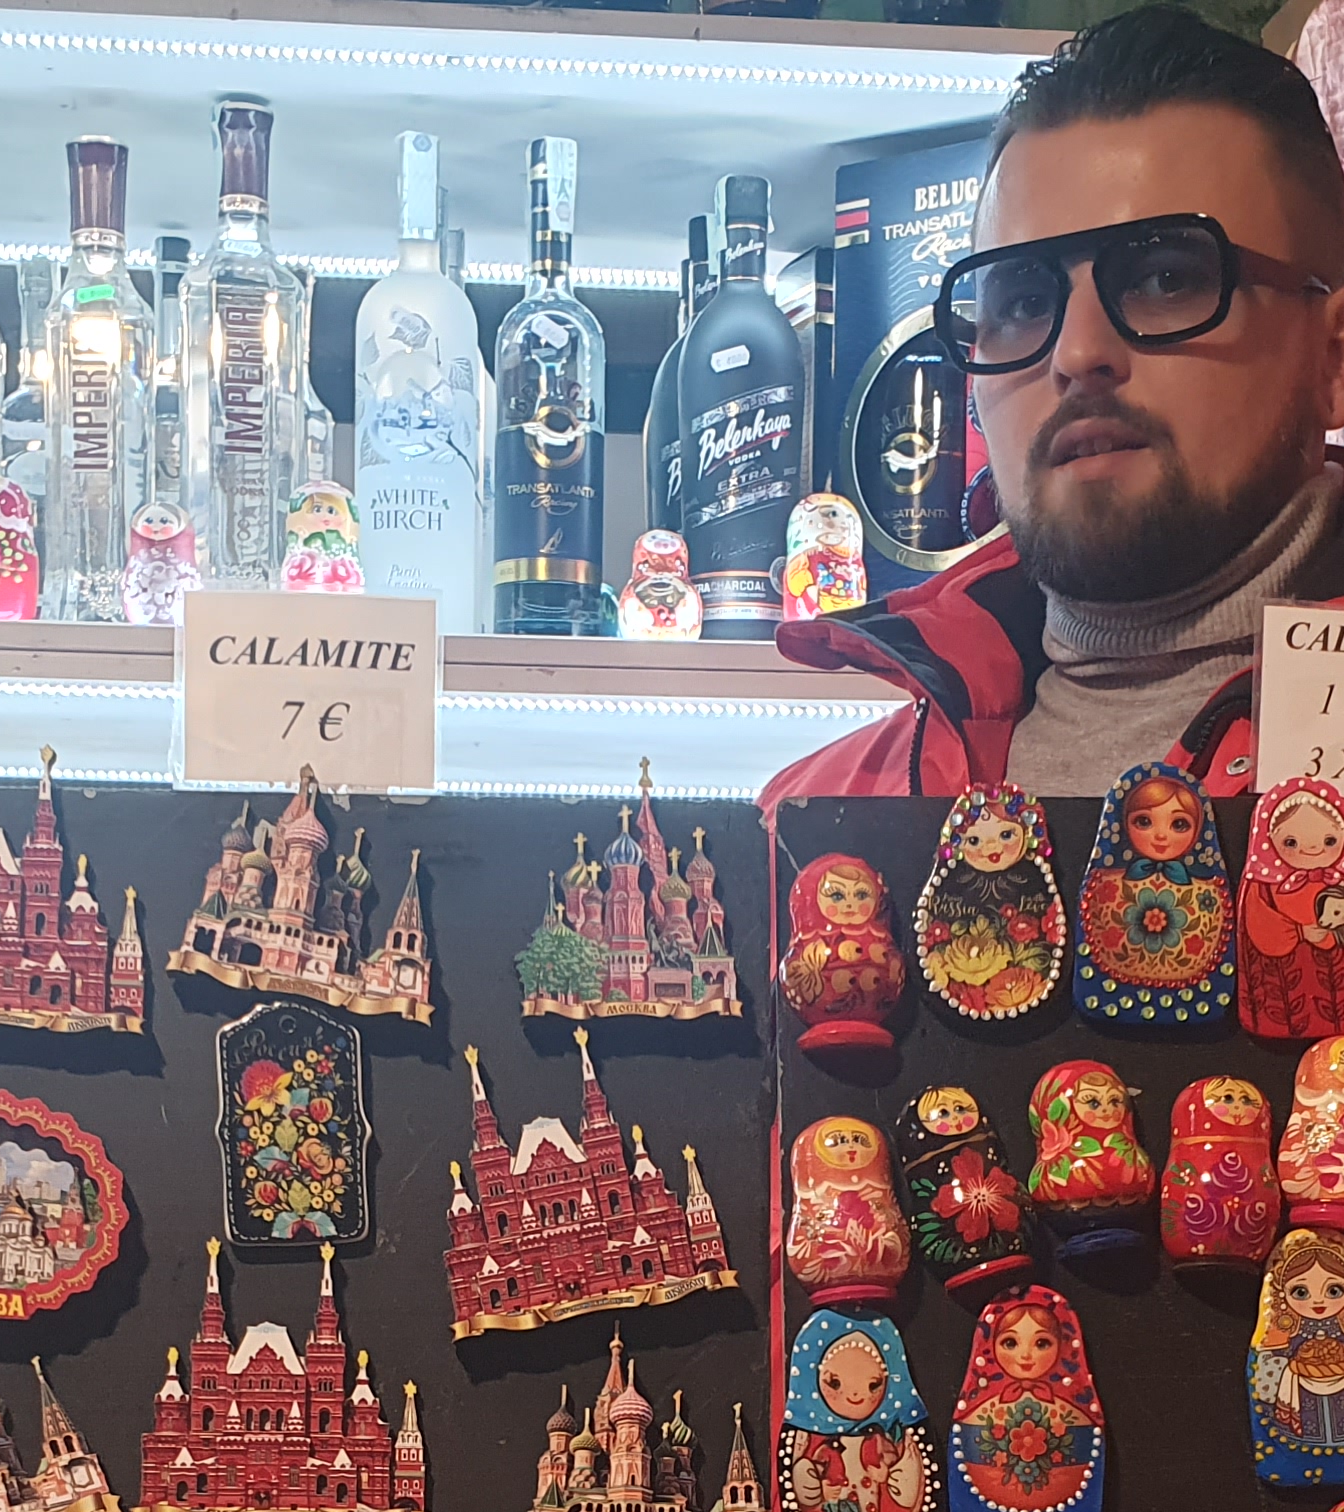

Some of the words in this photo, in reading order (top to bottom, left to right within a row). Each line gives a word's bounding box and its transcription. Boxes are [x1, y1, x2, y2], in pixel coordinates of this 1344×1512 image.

[914, 178, 981, 212] BELUG
[882, 210, 973, 241] TRANSATL
[72, 351, 109, 472] IMPERI
[698, 409, 792, 481] Belenkaya
[728, 450, 761, 467] VODKA
[717, 466, 771, 492] EXTRA
[376, 489, 439, 508] WHITE
[373, 510, 442, 531] BIRCH
[209, 635, 416, 671] CALAMITE
[1319, 684, 1336, 715] 1
[281, 700, 306, 740] 7
[318, 702, 351, 742] €
[1305, 746, 1324, 777] 3
